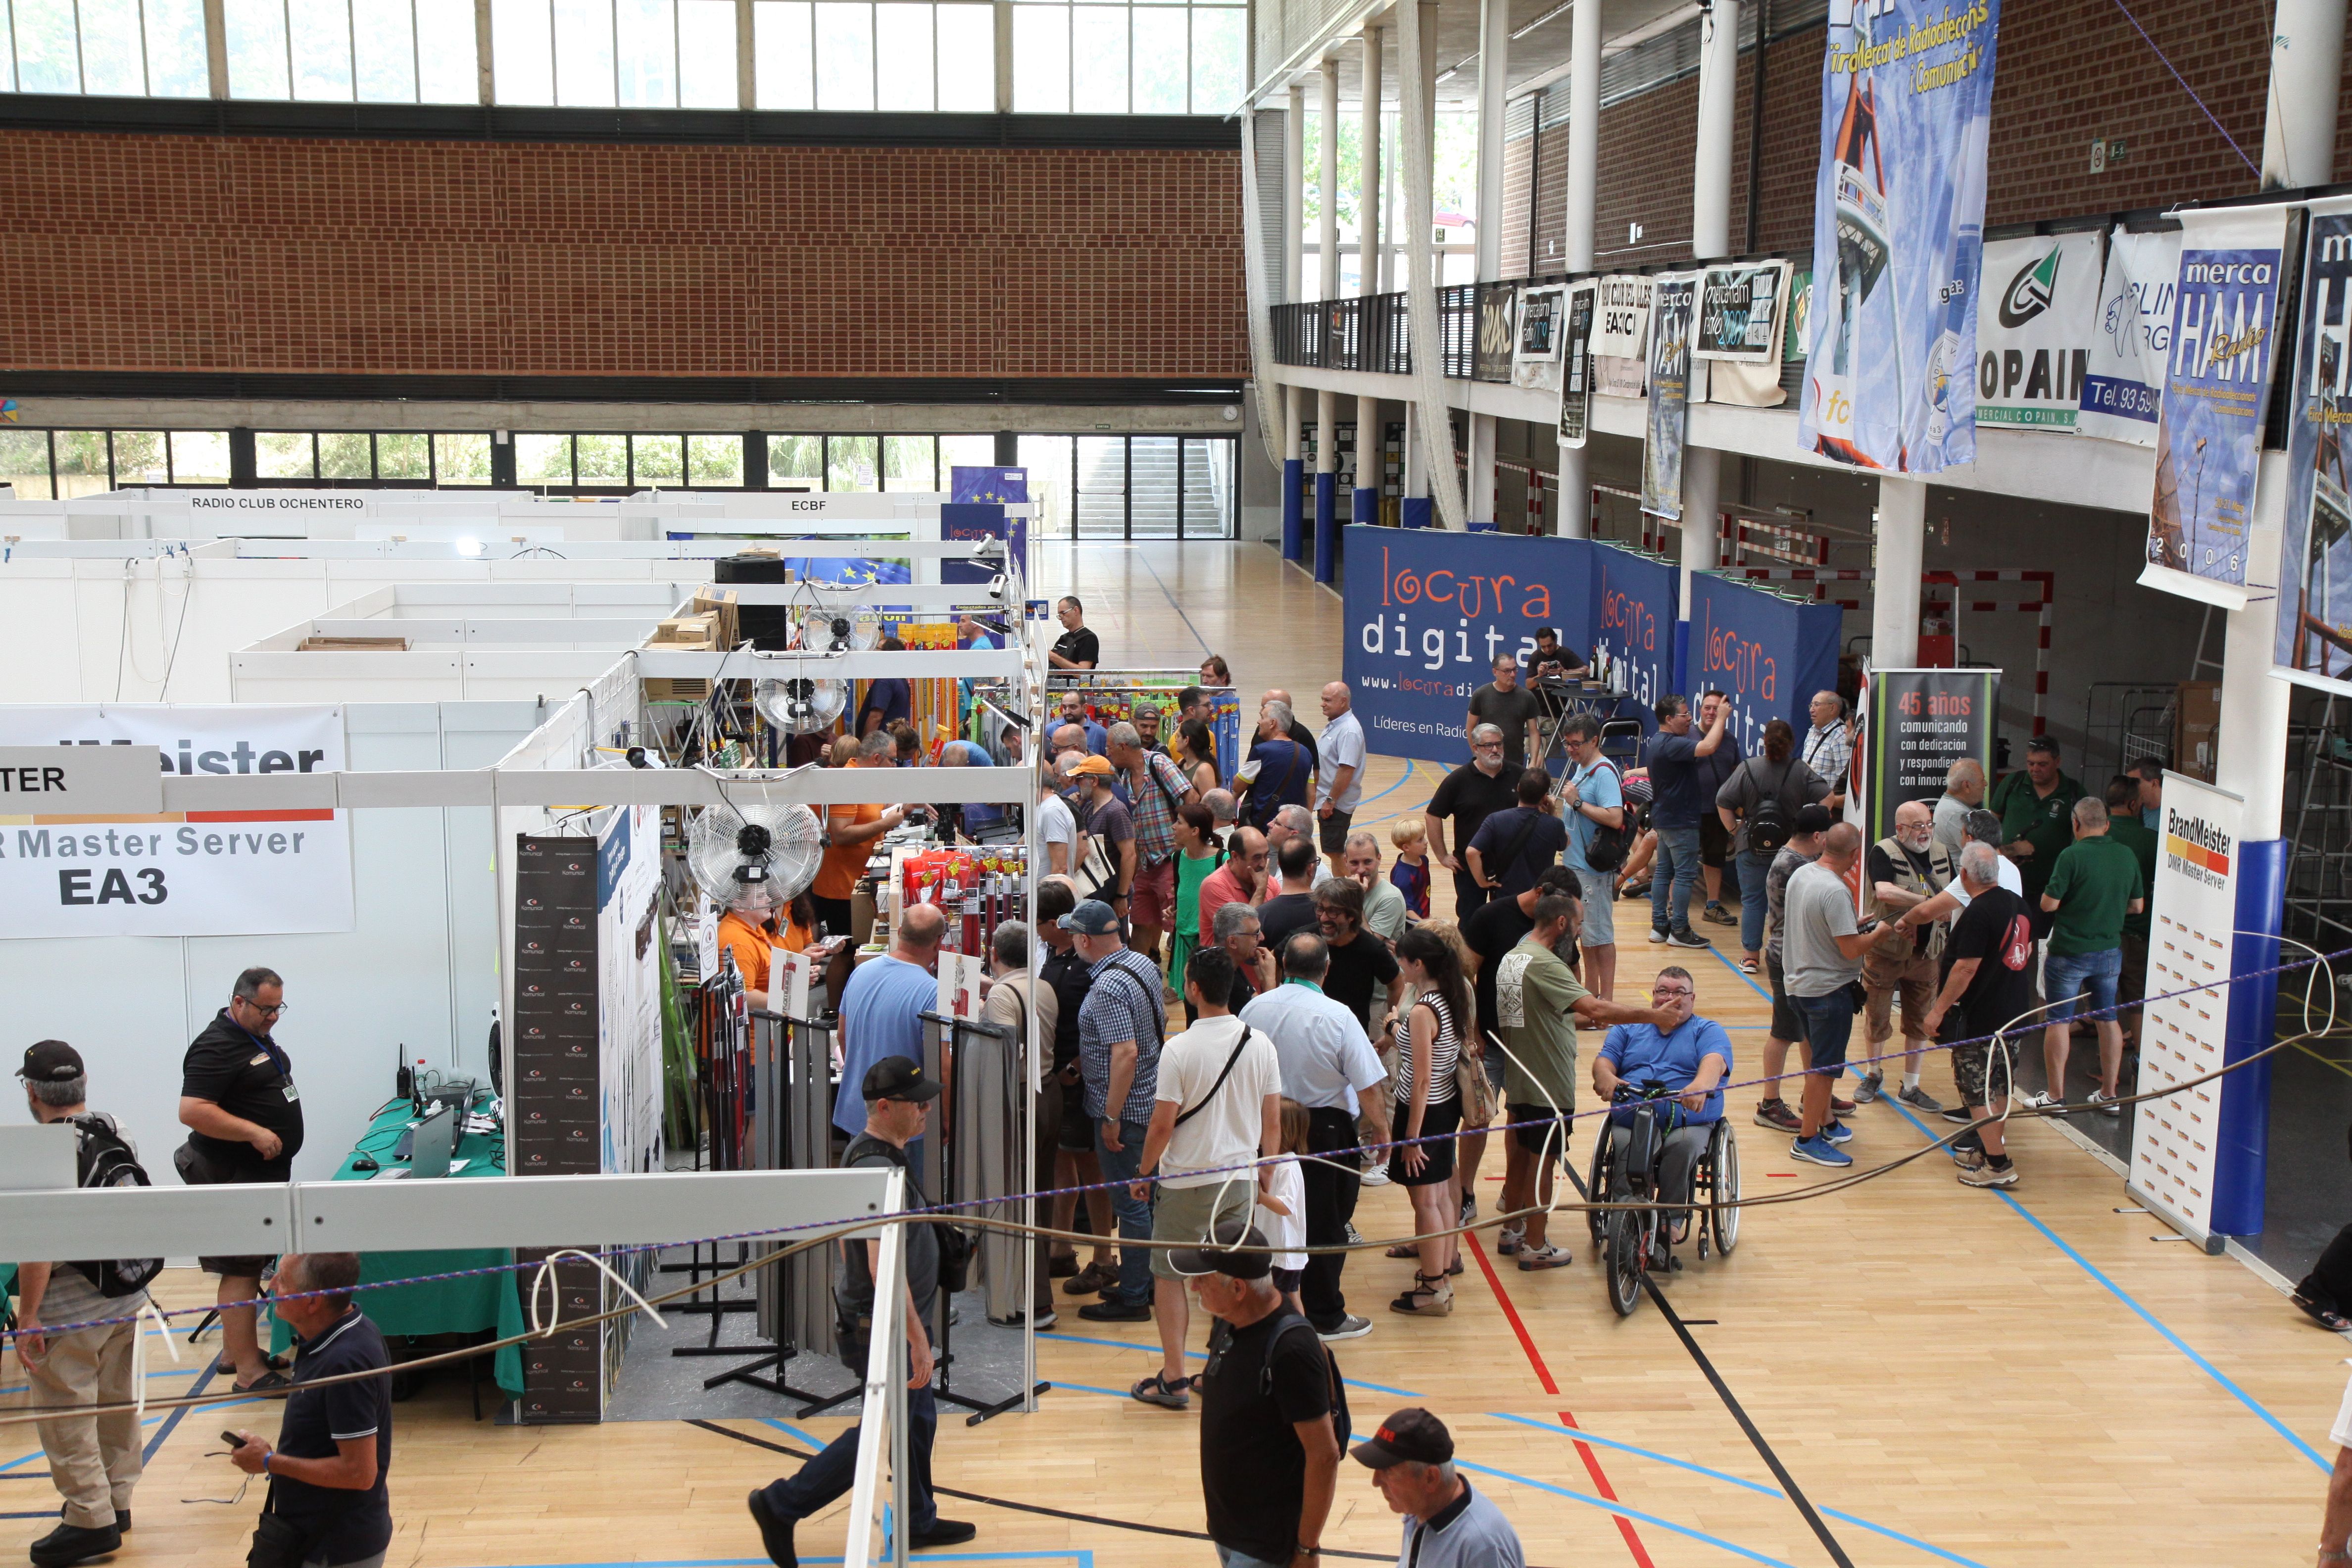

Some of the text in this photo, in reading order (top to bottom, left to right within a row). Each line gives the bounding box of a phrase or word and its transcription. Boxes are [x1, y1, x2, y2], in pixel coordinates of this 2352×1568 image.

[1830, 43, 1858, 73] ira
[1857, 35, 1893, 70] Mercat
[1894, 25, 1906, 60] de
[2186, 262, 2271, 285] merca
[2173, 291, 2263, 384] HAM
[2209, 324, 2268, 367] Radio
[1976, 349, 2091, 401] OPAIN
[2091, 382, 2116, 406] Tel.
[2120, 387, 2135, 410] 93
[1975, 410, 2012, 422] MERCIAL
[192, 498, 363, 509] RADIO CLUB OCHENTERO
[792, 500, 826, 510] ECBF
[1381, 546, 1551, 619] locura
[1600, 564, 1655, 652] locura
[1703, 597, 1776, 702] locura
[1362, 671, 1472, 697] www.locuradi
[1898, 691, 1971, 716] 45 años
[1373, 715, 1416, 733] Líderes
[1419, 724, 1433, 735] en
[1900, 719, 1968, 733] comunicando
[1919, 738, 1966, 750] dedicación
[1900, 756, 1961, 771] y respondien
[1900, 774, 1948, 786] con innova
[17, 828, 162, 859] Master
[176, 826, 305, 856] Server
[2168, 807, 2231, 857] BrandMeister
[2167, 853, 2225, 891] DMR Master Server
[58, 867, 169, 906] EA3
